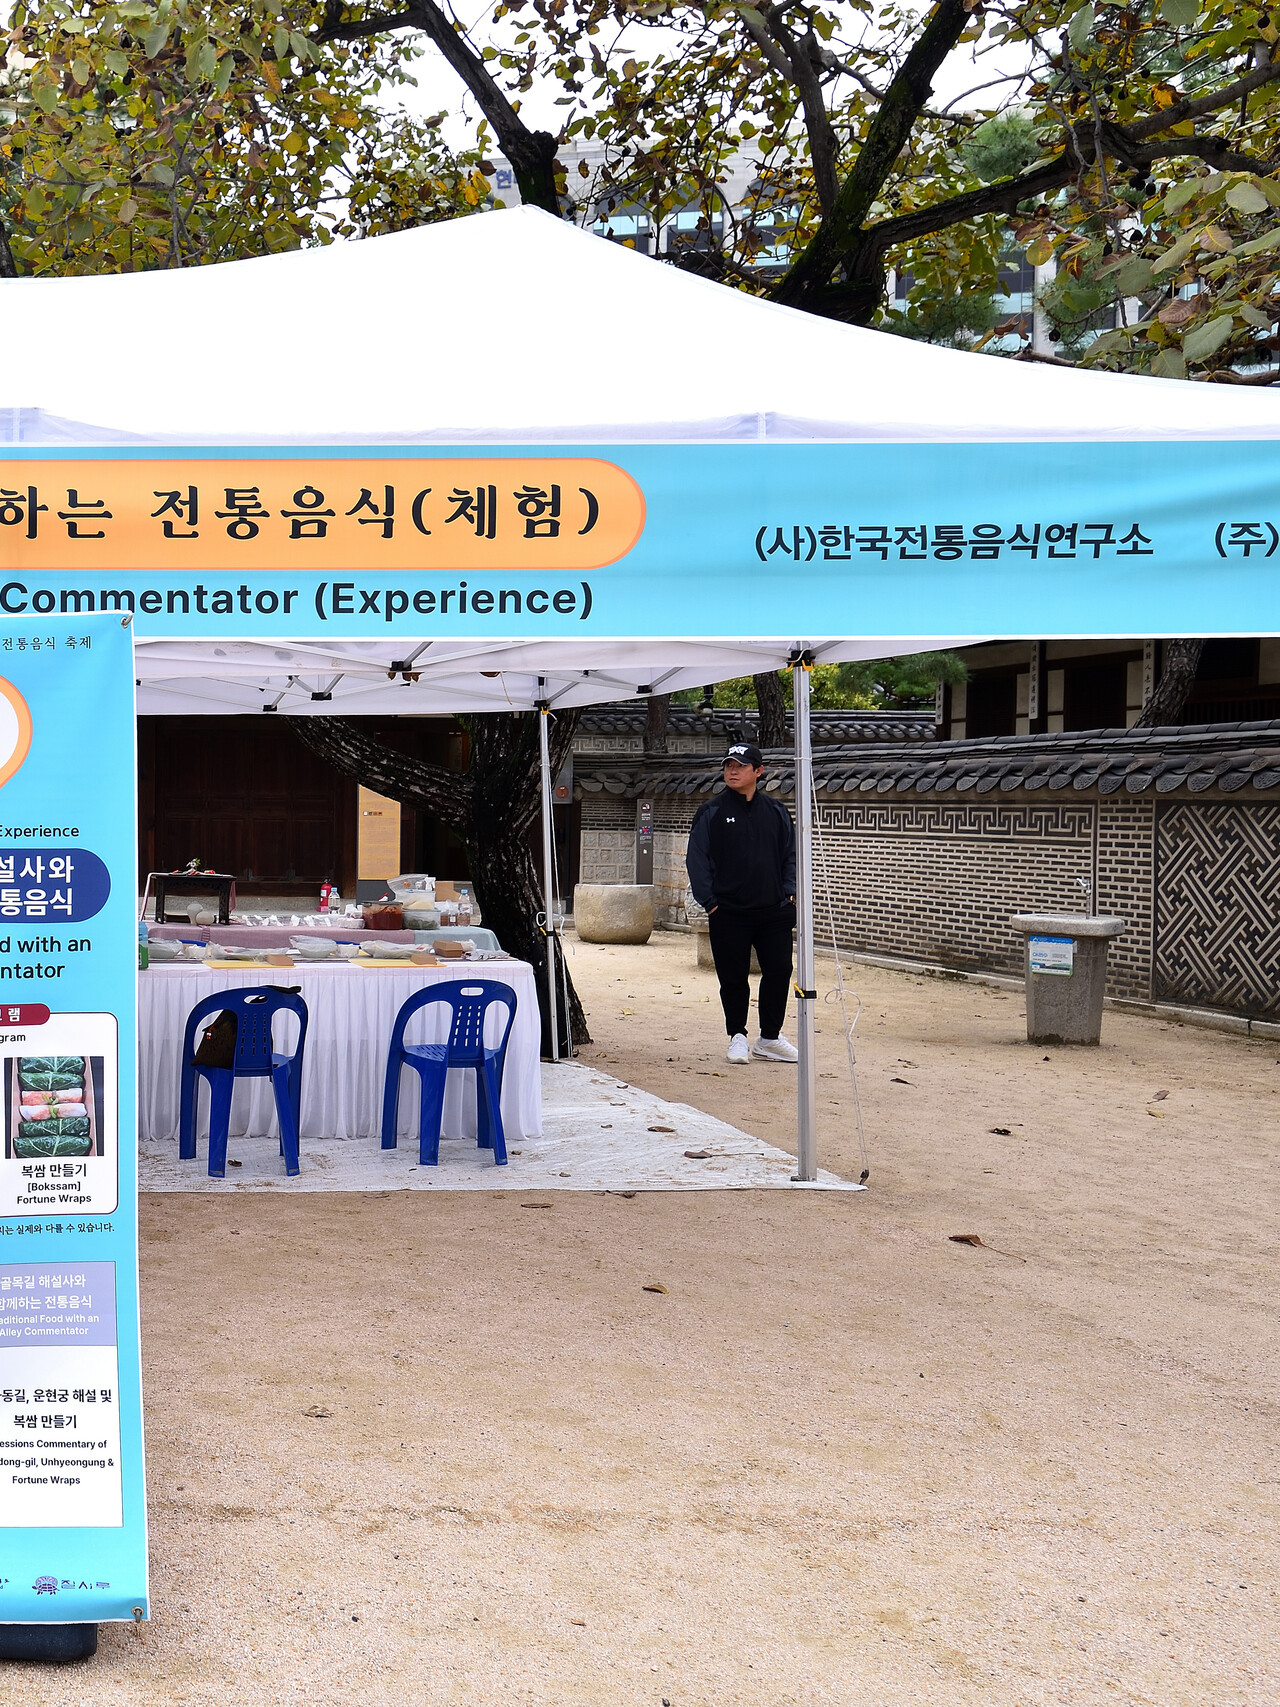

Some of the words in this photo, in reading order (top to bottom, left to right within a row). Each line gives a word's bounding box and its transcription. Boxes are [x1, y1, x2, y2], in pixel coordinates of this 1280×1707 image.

[150, 483, 600, 541] 전통음식(체험)
[755, 522, 1154, 562] (사)한국전통음식연구소
[1215, 521, 1279, 558] (주)
[0, 581, 298, 616] Commentator
[314, 581, 594, 622] (Experience)
[1, 636, 56, 651] 전통음식
[64, 635, 92, 650] 축제
[17, 935, 61, 953] with
[67, 937, 91, 951] an
[21, 1164, 46, 1178] 복쌈
[50, 1163, 87, 1178] 만들기
[27, 1181, 81, 1193] [Bokssam]
[17, 1195, 56, 1204] Fortune
[58, 1194, 92, 1206] Wraps
[16, 1224, 43, 1235] 실제와
[66, 1223, 75, 1234] 수
[77, 1222, 115, 1233] 있습니다.
[0, 1276, 36, 1290] 골목길
[38, 1274, 86, 1289] 해설사와
[44, 1294, 92, 1309] 전통음식
[40, 1314, 63, 1324] Food
[65, 1314, 85, 1323] with
[87, 1315, 100, 1323] an
[0, 1327, 22, 1337] Alley
[24, 1326, 89, 1336] Commentator
[33, 1388, 69, 1403] 운현궁
[73, 1388, 97, 1403] 해설
[100, 1389, 112, 1403] 및
[13, 1415, 37, 1429] 복쌈
[41, 1415, 78, 1429] 만들기
[36, 1439, 95, 1450] Commentary
[98, 1439, 108, 1448] of
[41, 1457, 105, 1468] Unhyeongung
[107, 1458, 115, 1467] &
[12, 1476, 48, 1485] Fortune
[50, 1476, 81, 1486] Wraps
